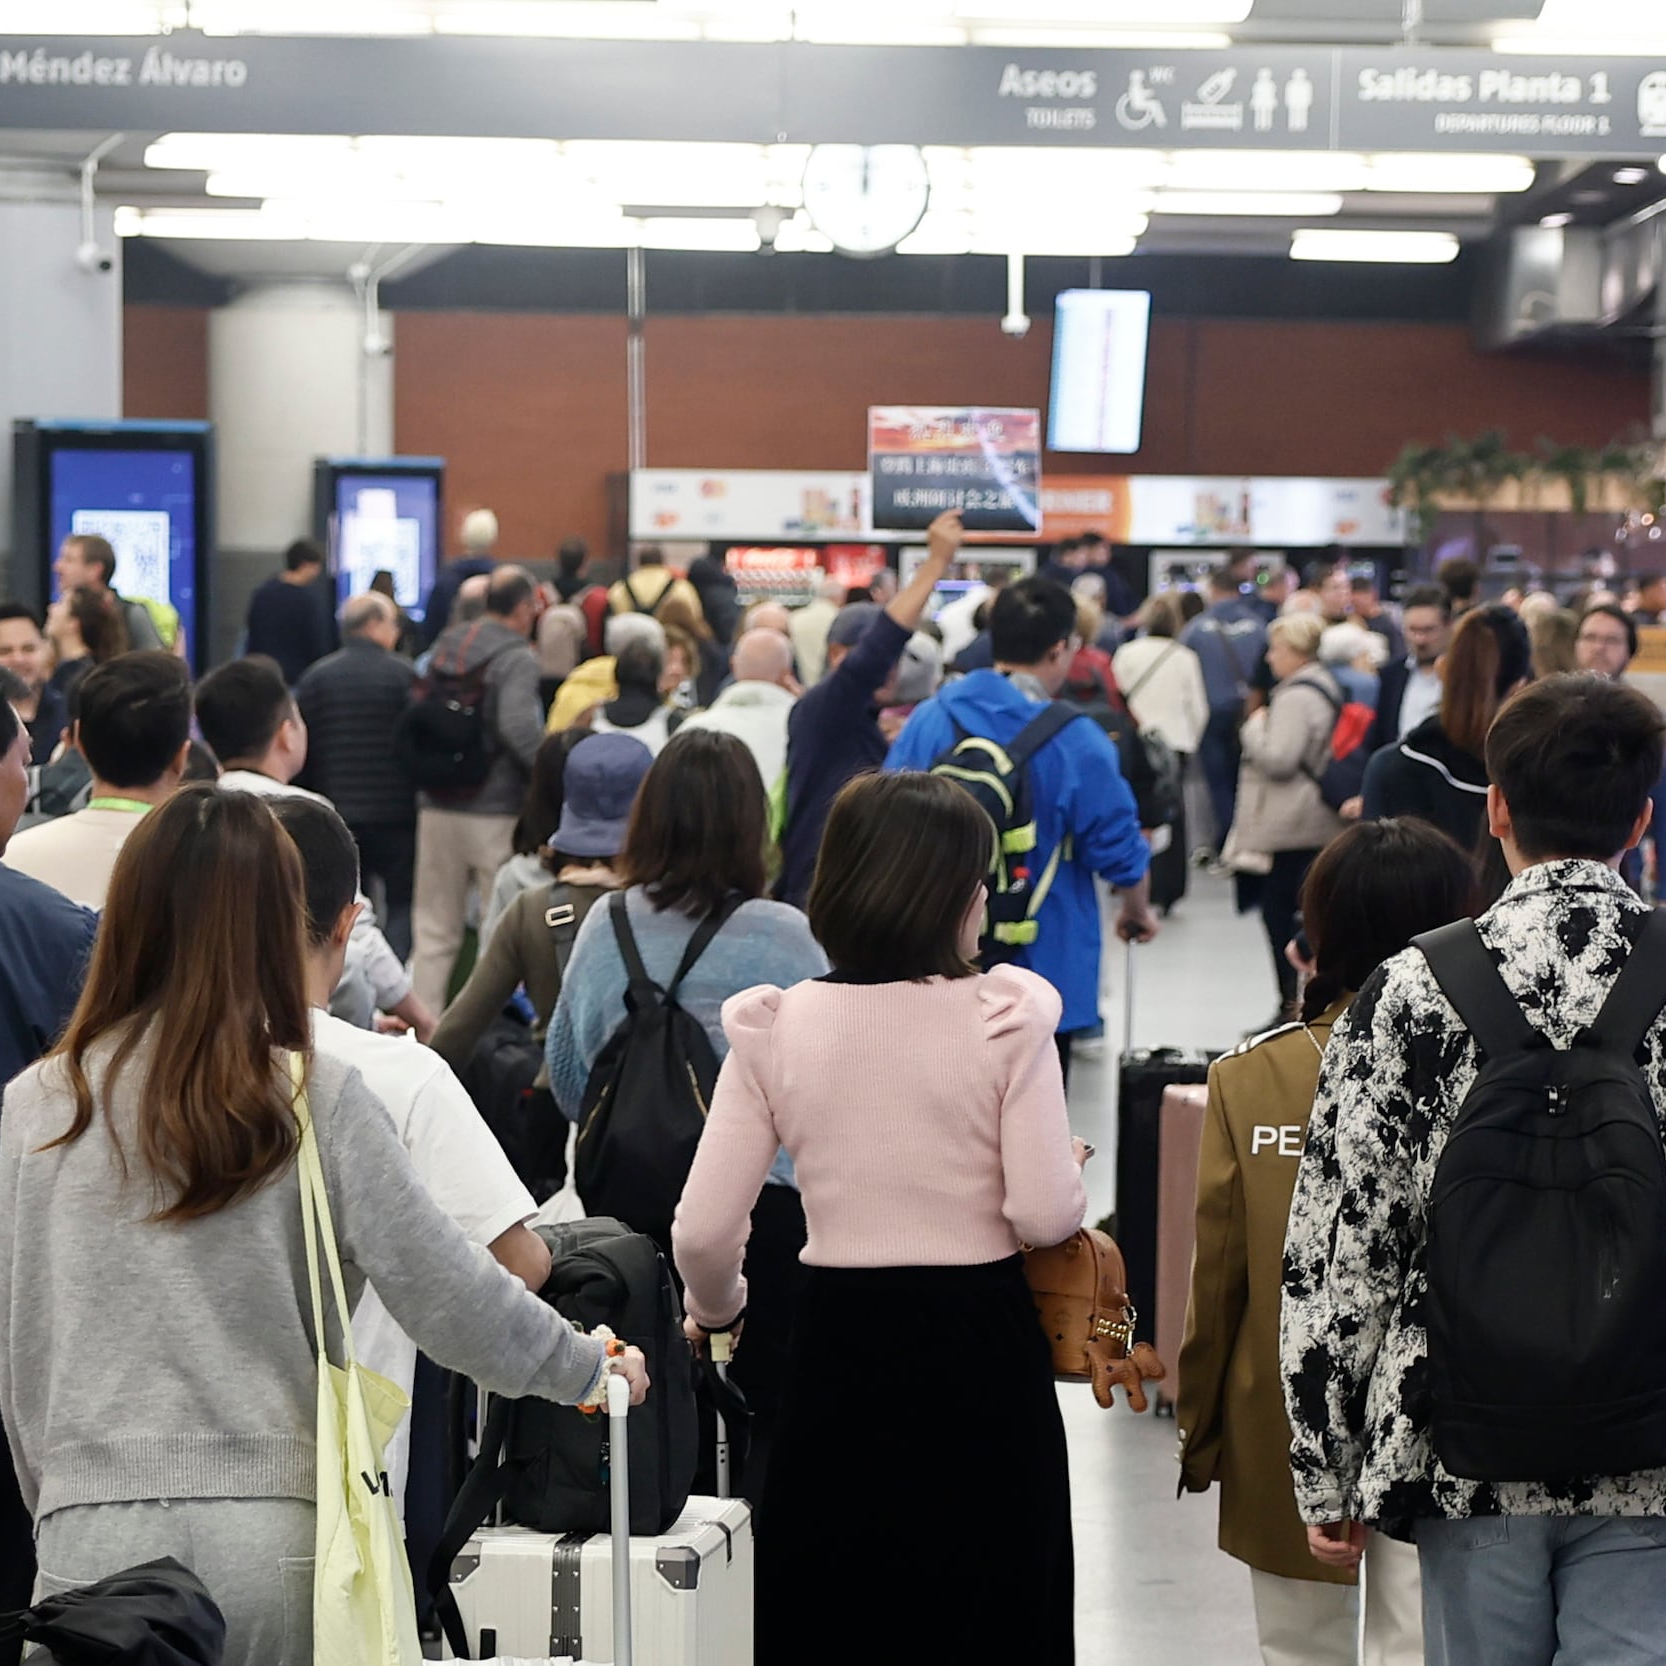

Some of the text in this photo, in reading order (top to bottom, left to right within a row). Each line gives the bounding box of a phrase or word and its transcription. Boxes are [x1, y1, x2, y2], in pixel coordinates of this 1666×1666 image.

[139, 46, 248, 87] Álvaro
[997, 62, 1098, 99] Aseos
[1358, 66, 1613, 104] Salidas Planta 1
[1251, 1125, 1304, 1156] PE
